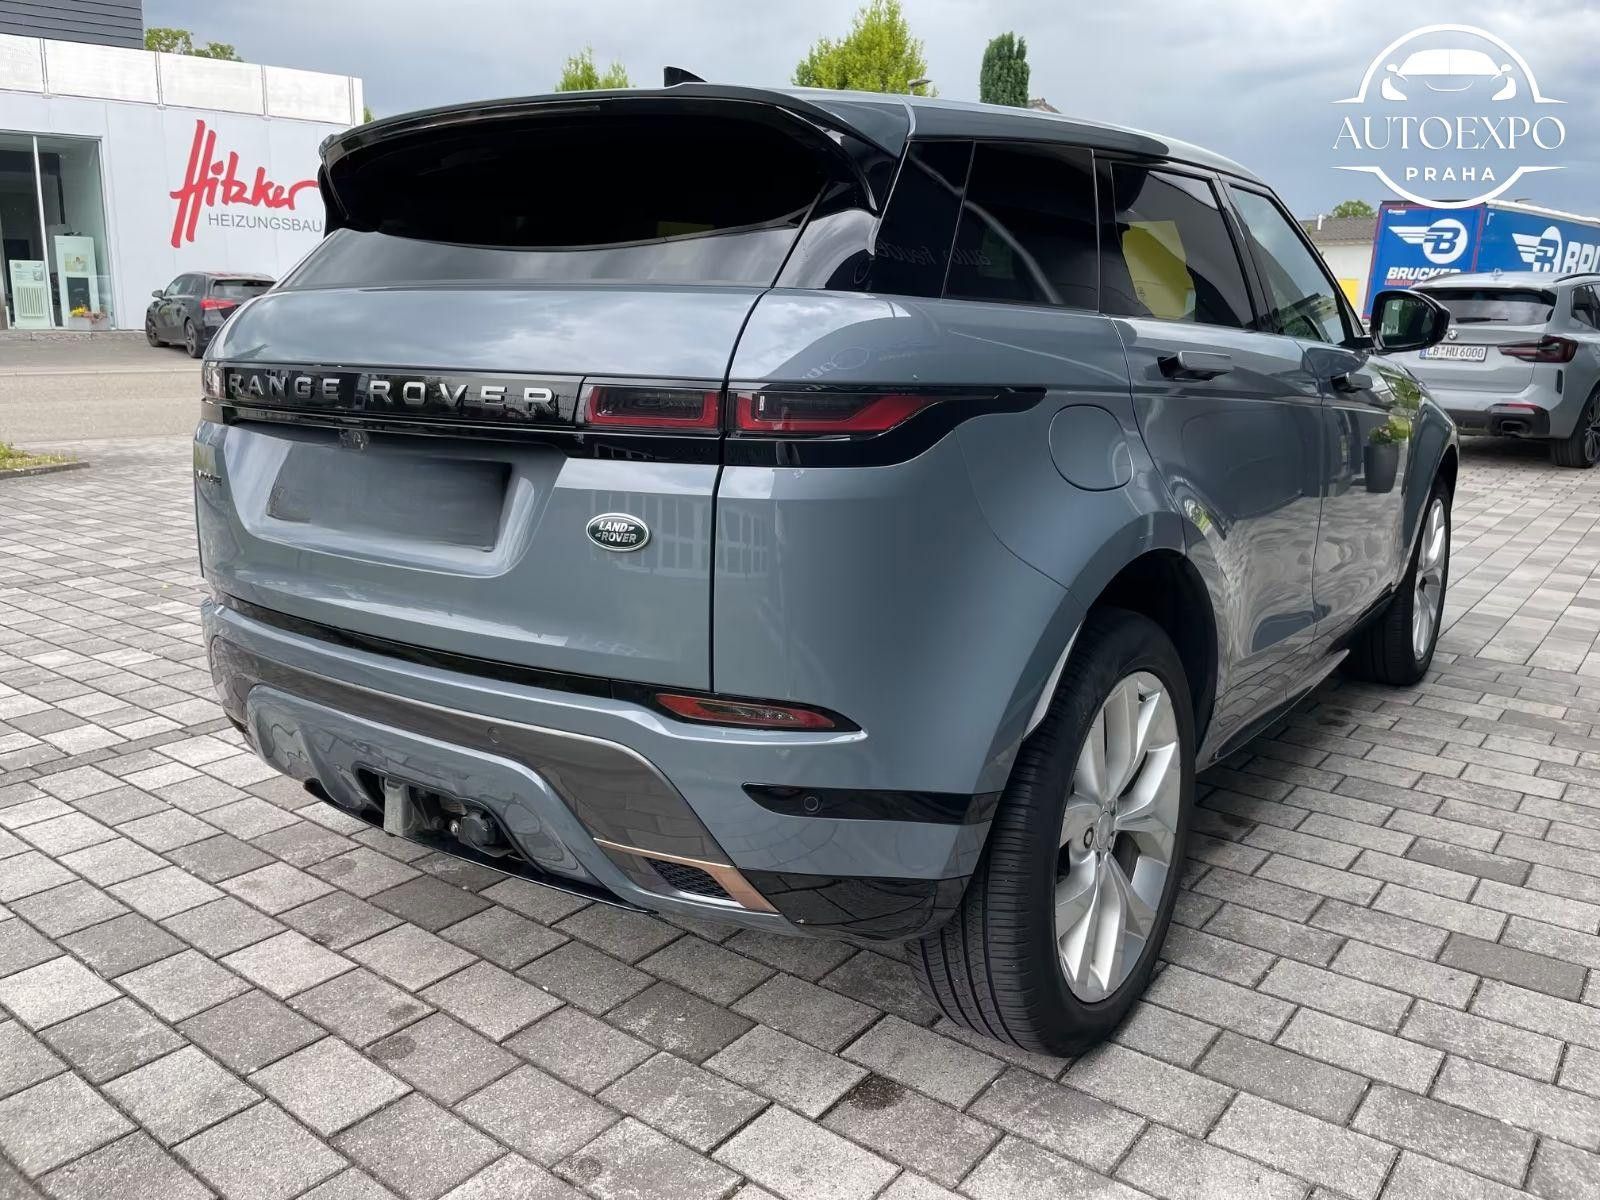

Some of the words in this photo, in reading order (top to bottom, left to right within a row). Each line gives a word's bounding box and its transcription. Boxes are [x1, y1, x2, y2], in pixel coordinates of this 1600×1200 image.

[169, 119, 319, 248] Hitzker
[207, 212, 323, 234] HEIZUNGSBAU
[228, 373, 340, 399] RANGE
[369, 380, 553, 410] ROVER
[598, 520, 628, 532] LAND
[600, 531, 637, 543] ROVER
